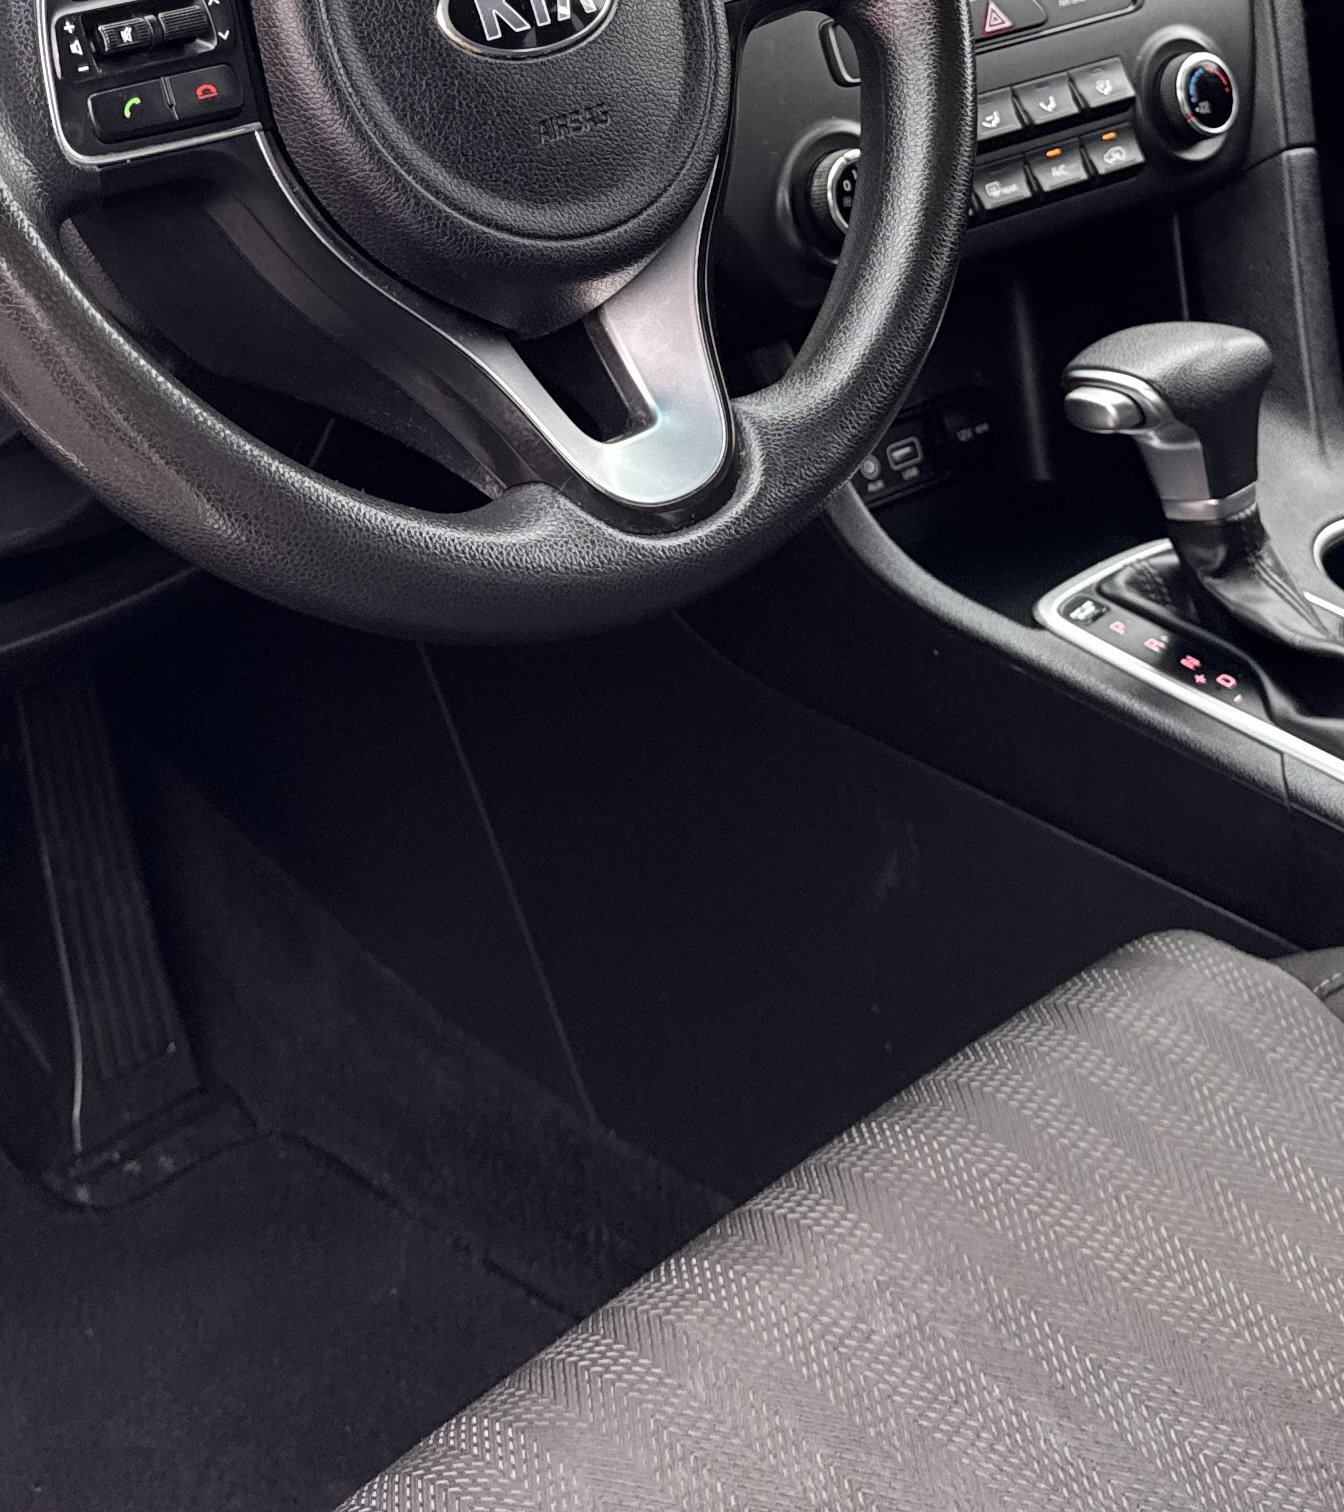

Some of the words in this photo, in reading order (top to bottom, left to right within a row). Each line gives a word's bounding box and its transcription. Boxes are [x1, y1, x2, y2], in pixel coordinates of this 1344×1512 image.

[1110, 621, 1126, 635] P
[1144, 638, 1166, 653] R
[1216, 673, 1237, 689] D
